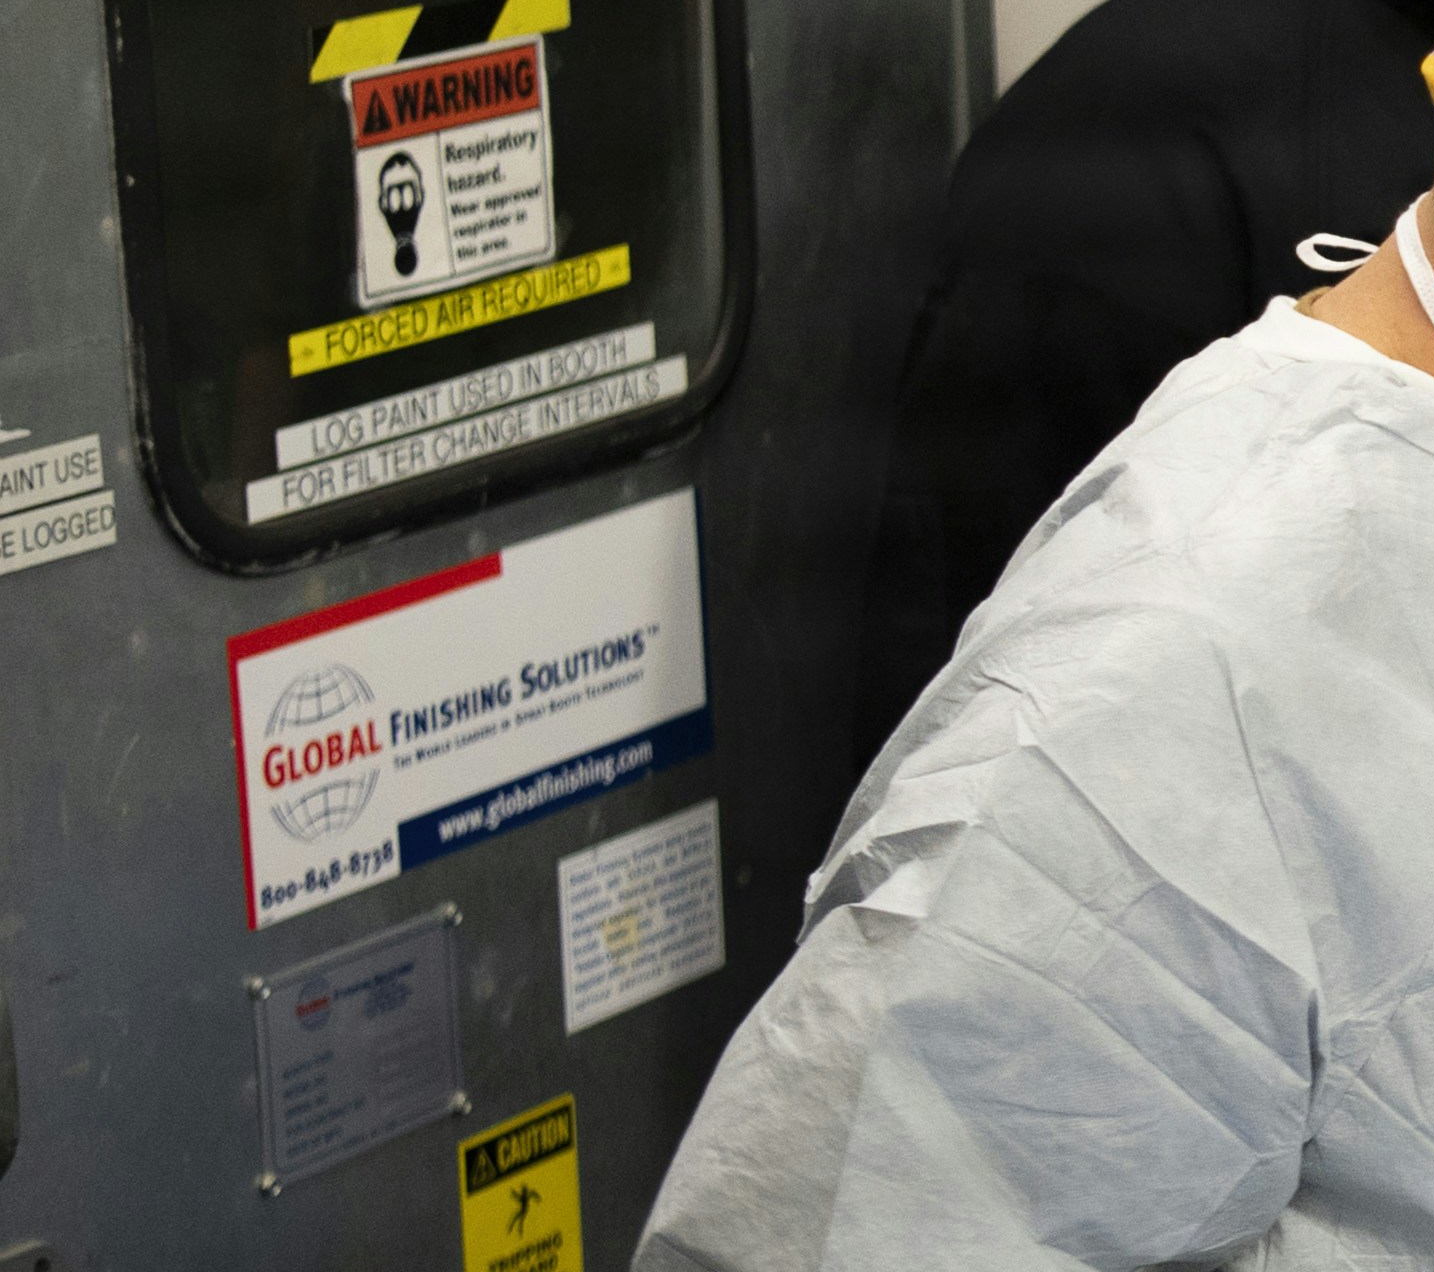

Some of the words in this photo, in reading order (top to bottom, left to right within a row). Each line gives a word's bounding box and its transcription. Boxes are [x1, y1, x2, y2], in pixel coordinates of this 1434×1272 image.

[392, 57, 535, 125] WARNING
[444, 129, 539, 165] Respiratory
[324, 307, 428, 361] FORCED
[437, 293, 476, 329] AIR
[482, 259, 601, 316] REQUIRED
[311, 415, 364, 456] LOG
[372, 392, 439, 437] PAINT
[448, 368, 513, 418] USED
[521, 358, 541, 388] IN
[549, 331, 627, 380] BOOTH
[0, 460, 49, 498] AINT
[54, 448, 98, 484] USE
[282, 465, 336, 509] FOR
[342, 436, 426, 486] FILTER
[432, 409, 530, 466] CHANGE
[537, 369, 661, 430] INTERVALS
[0, 531, 16, 559] E
[22, 504, 117, 553] LOGGED
[262, 720, 383, 789] GLOBAL
[390, 679, 512, 746] FINISHING
[438, 740, 653, 844] www.globalfinishing.com
[261, 839, 393, 909] 800-848-8738
[498, 1112, 569, 1171] CAUTION
